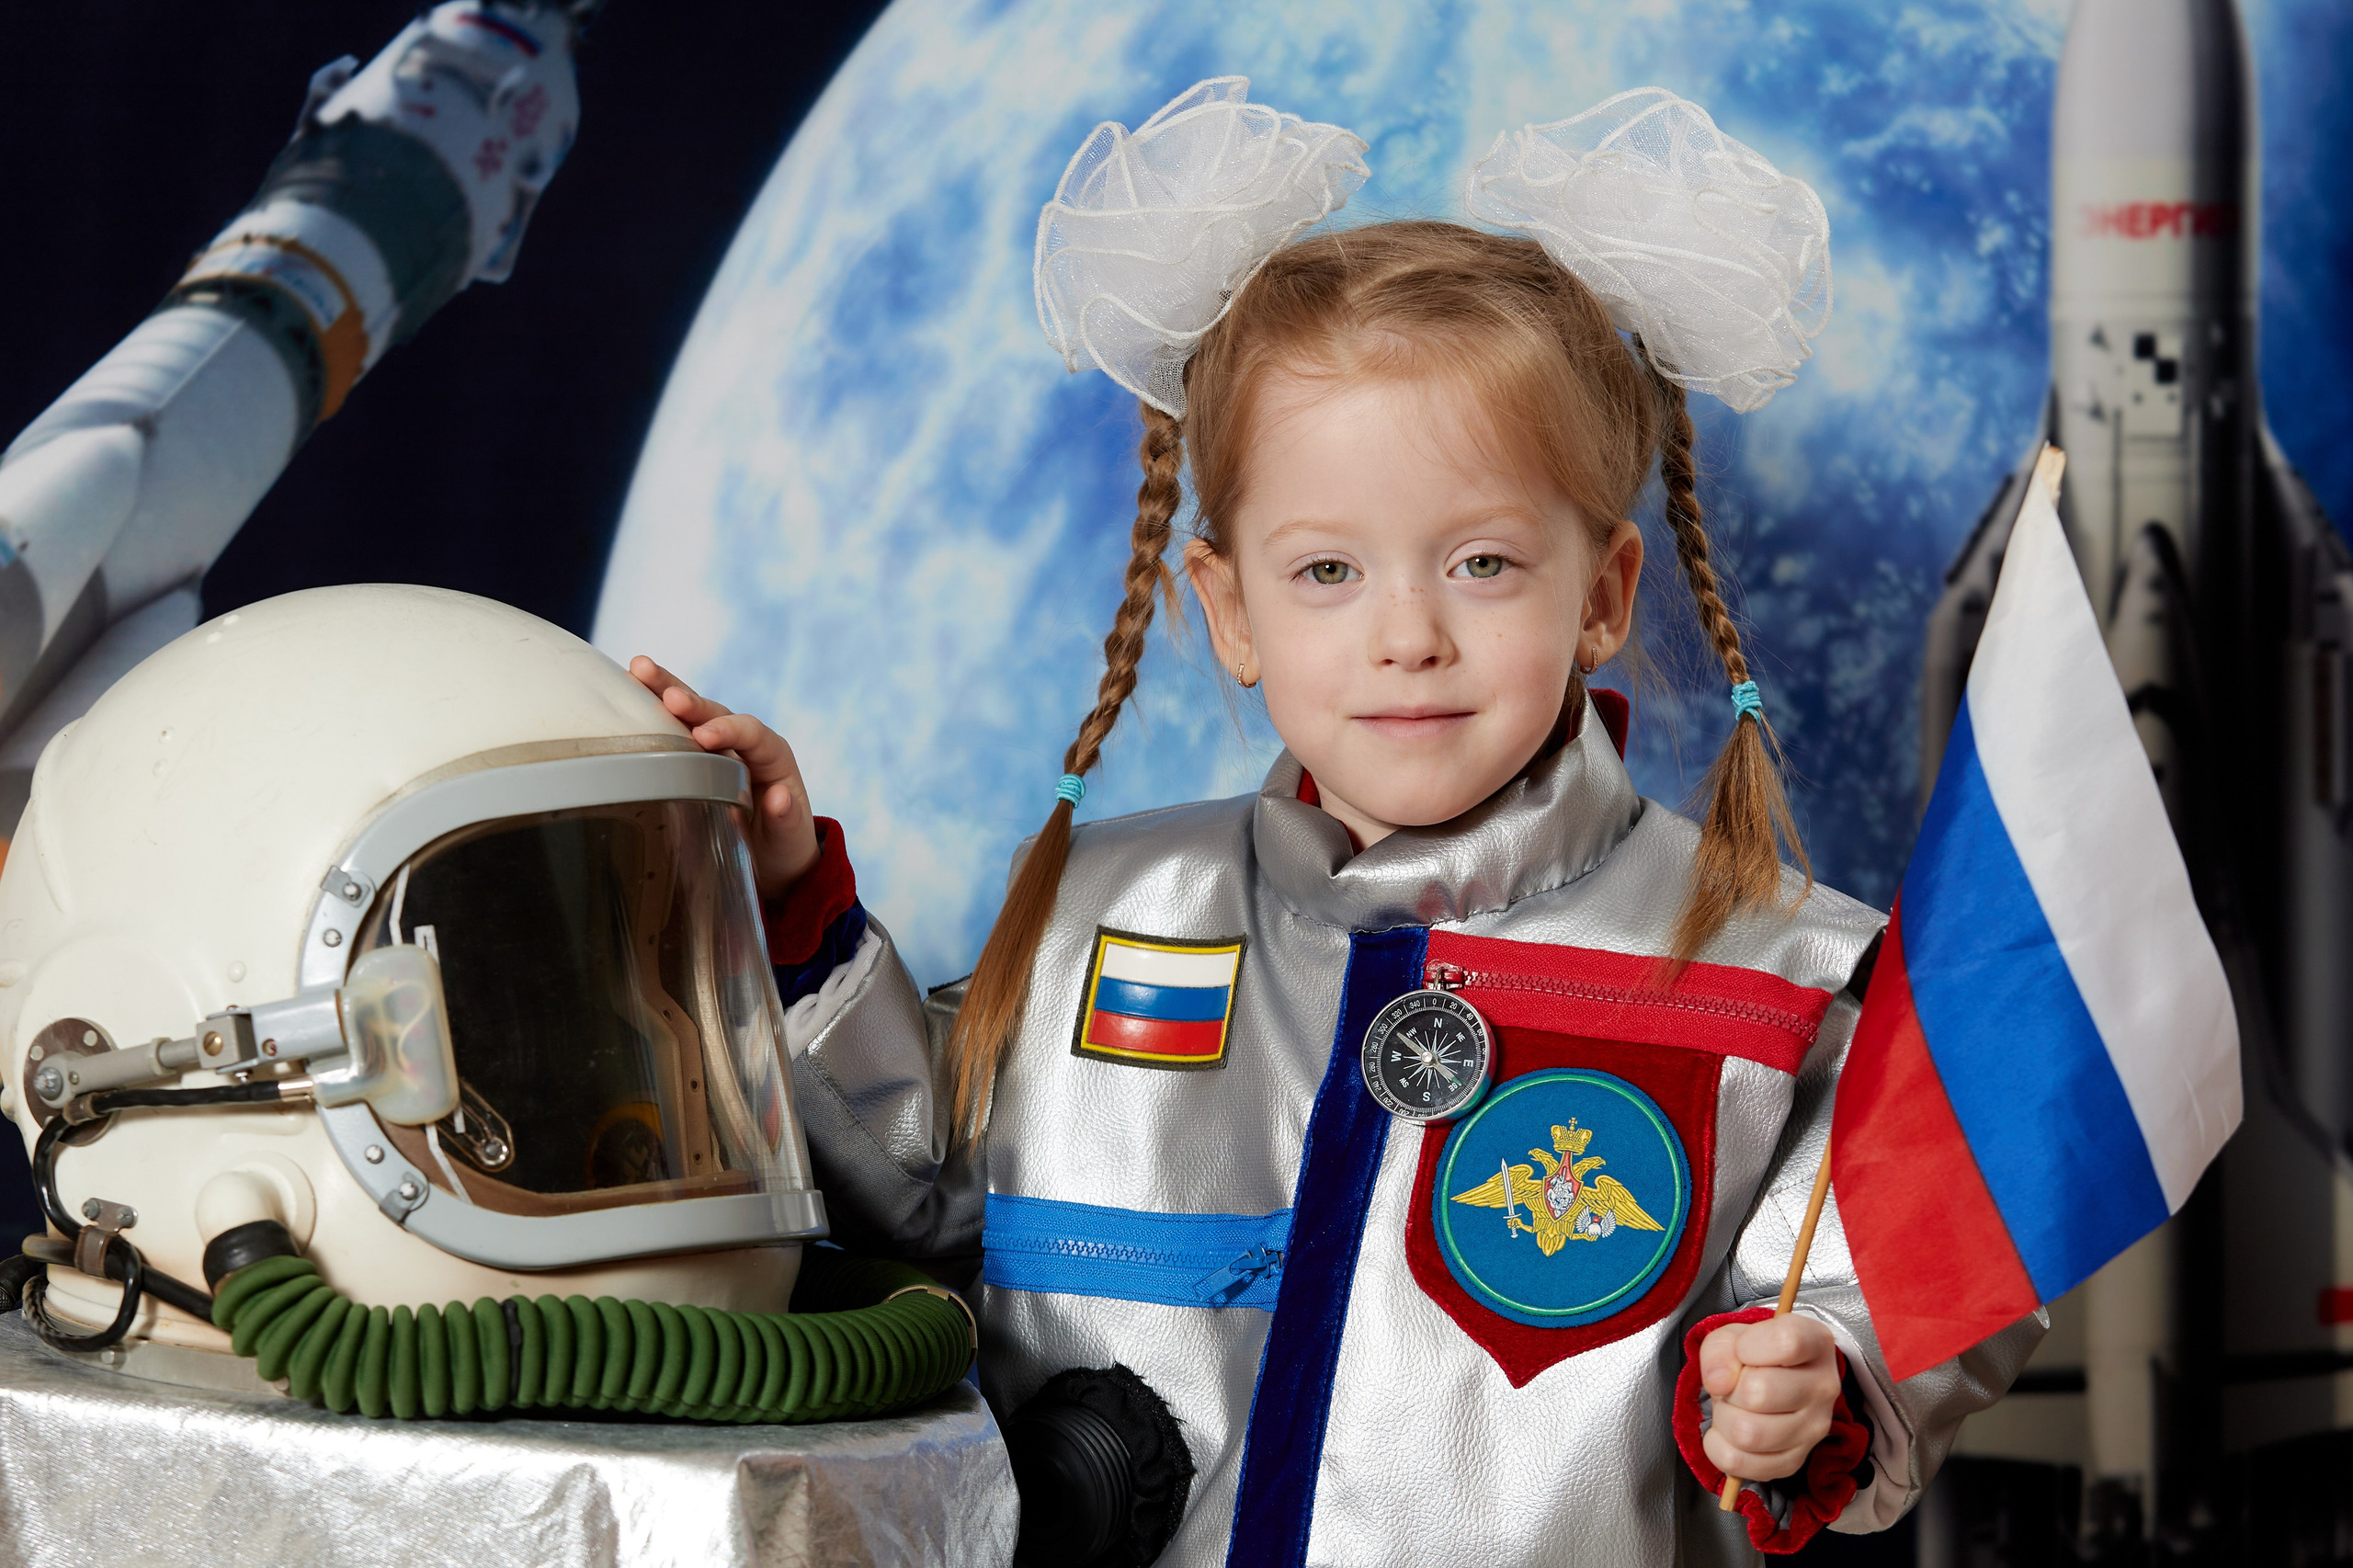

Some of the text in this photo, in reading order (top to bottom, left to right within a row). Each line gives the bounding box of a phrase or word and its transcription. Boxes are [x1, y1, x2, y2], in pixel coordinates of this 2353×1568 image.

[1409, 1000, 1421, 1009] 340
[1449, 1001, 1458, 1010] 20
[1392, 1008, 1403, 1019] 320
[1466, 1012, 1473, 1021] 40
[1433, 1017, 1443, 1028] N
[1378, 1023, 1388, 1035] 300
[1405, 1027, 1417, 1039] NW
[1455, 1031, 1466, 1043] NE
[1370, 1041, 1379, 1053] 280
[1391, 1050, 1403, 1062] W
[1463, 1059, 1474, 1067] E
[1372, 1080, 1382, 1091] 240
[1398, 1077, 1410, 1088] SW
[1448, 1082, 1459, 1092] SE
[1382, 1096, 1394, 1108] 220
[1422, 1091, 1431, 1102] S
